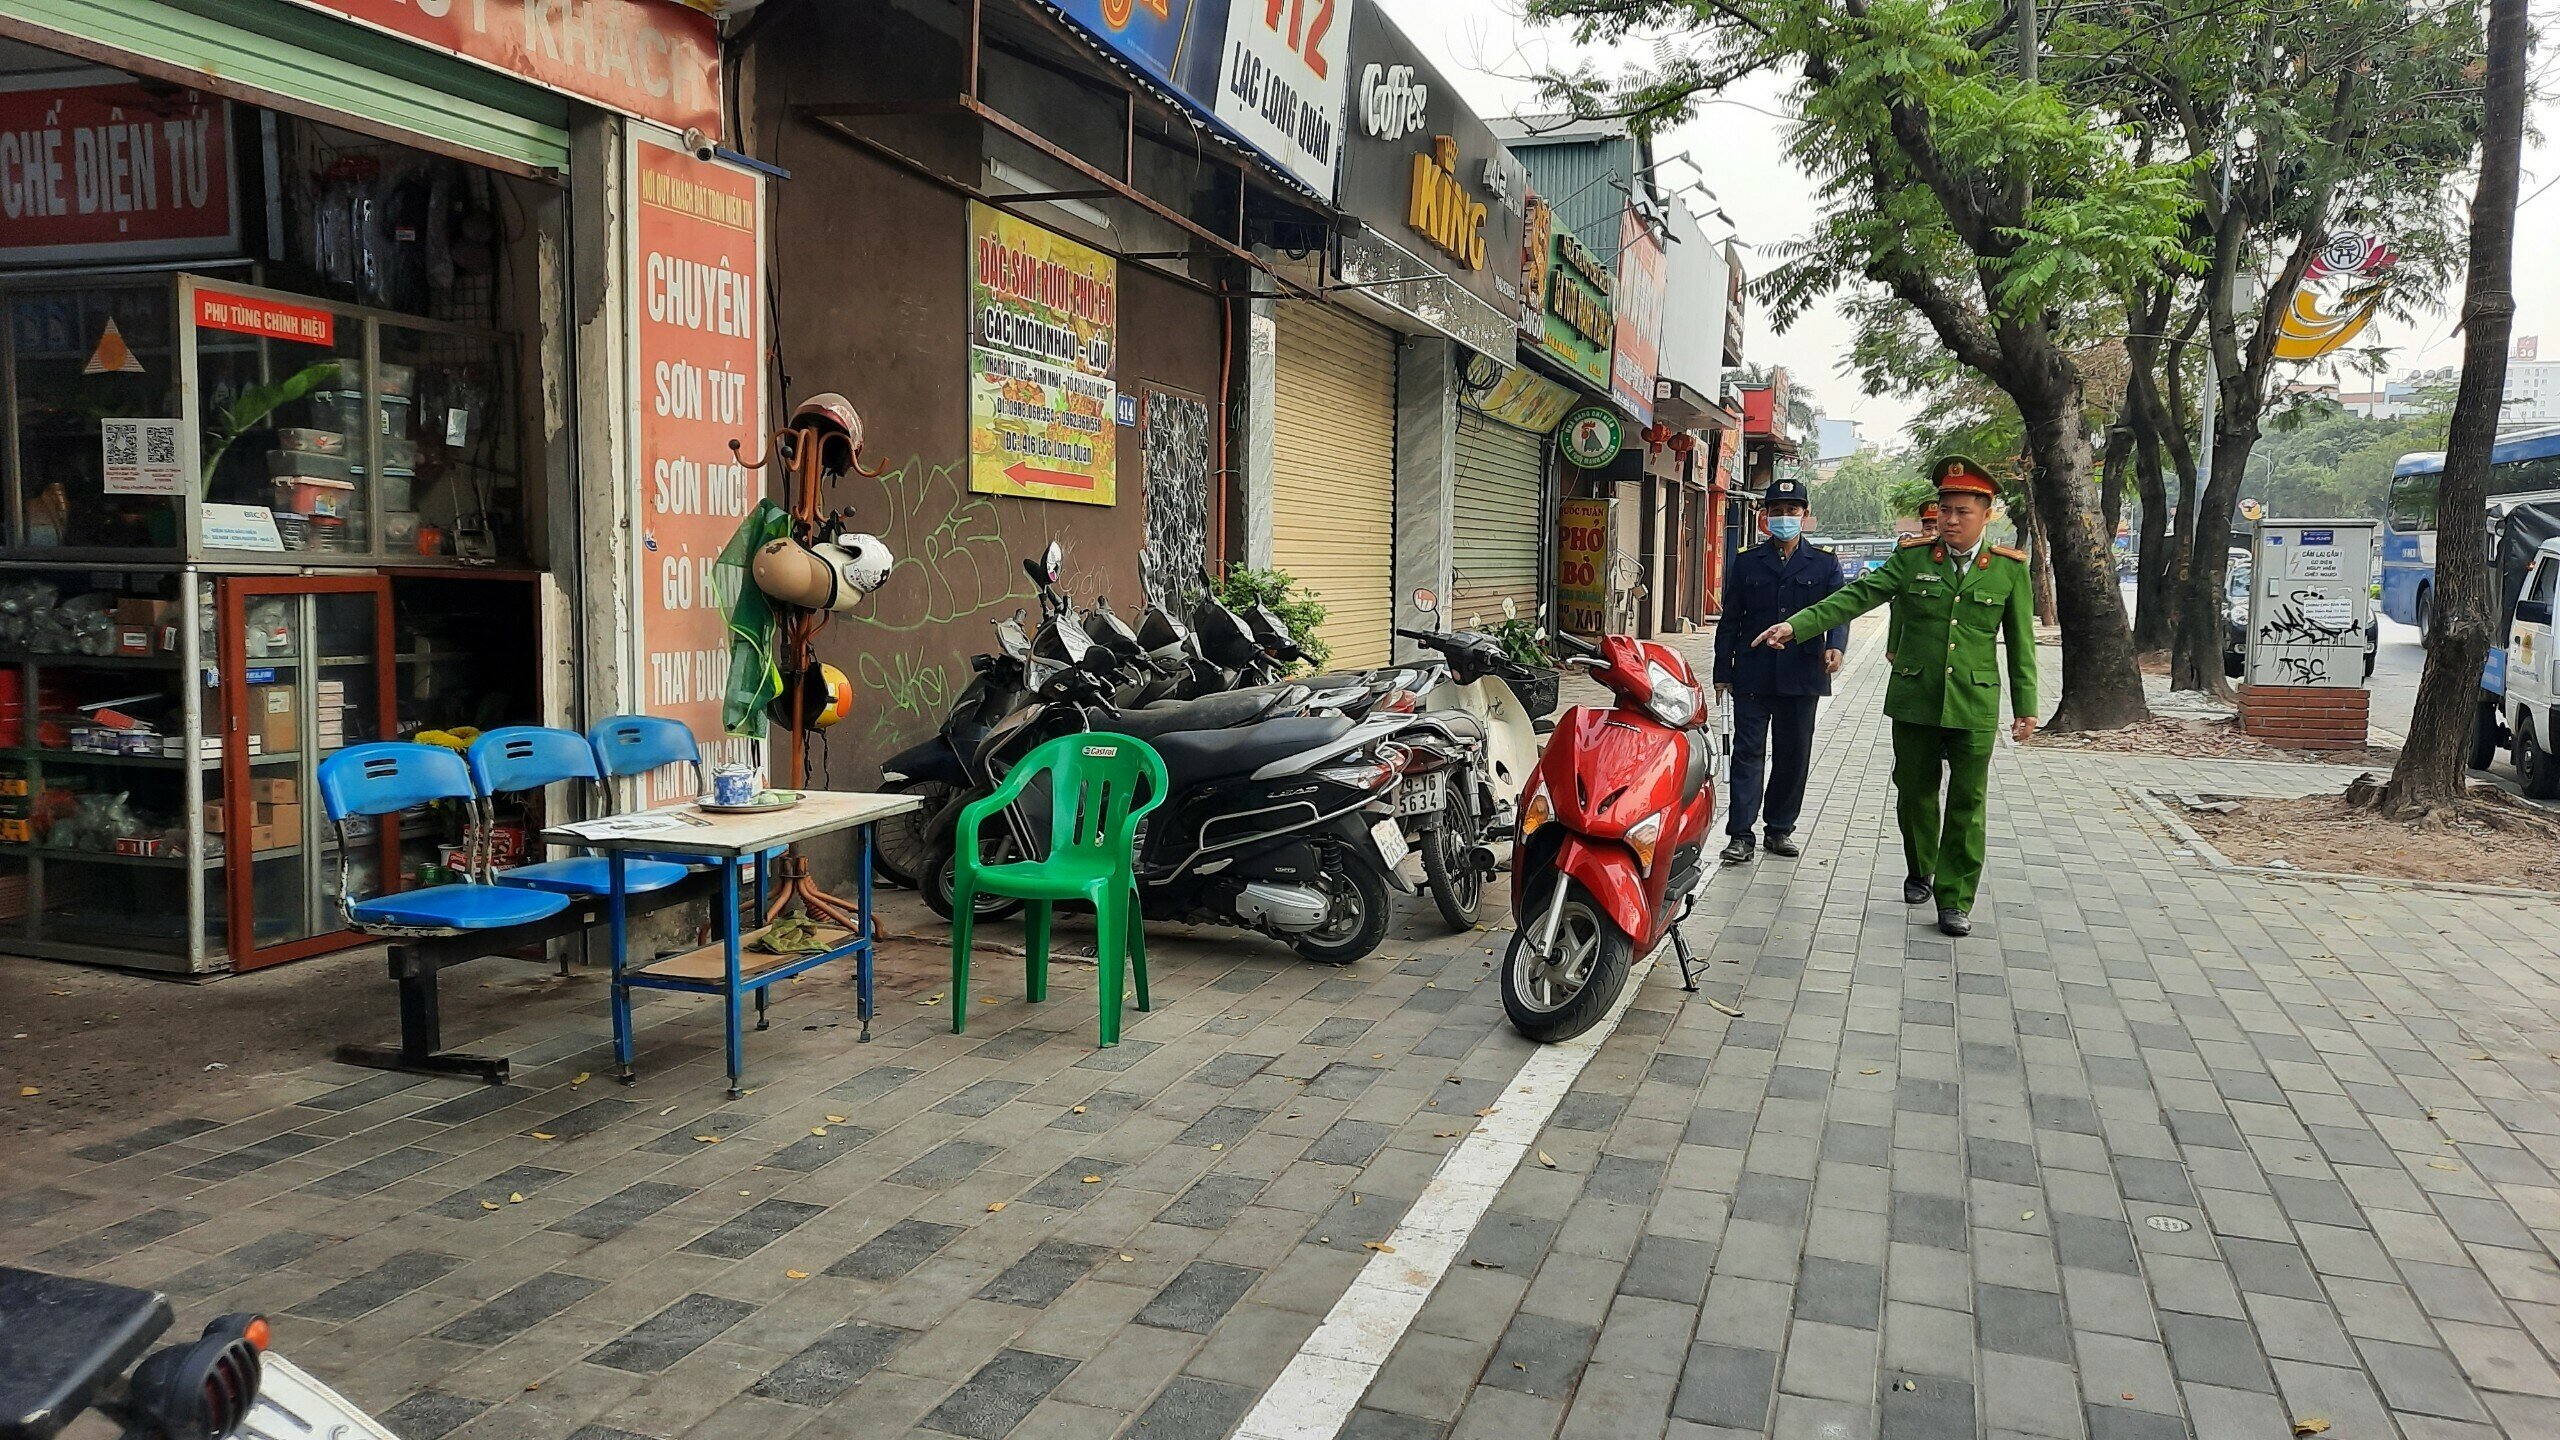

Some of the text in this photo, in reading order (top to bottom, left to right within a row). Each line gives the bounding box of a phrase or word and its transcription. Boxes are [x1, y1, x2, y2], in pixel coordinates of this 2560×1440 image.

[1230, 40, 1261, 111] LẠC
[1261, 67, 1298, 138] LONG
[1298, 102, 1332, 166] QUÂN
[1359, 63, 1428, 142] Coffee
[0, 91, 209, 232] CHẾ ĐIỆN TỬ
[671, 173, 694, 213] KHÁCH
[1409, 151, 1487, 271] KING
[647, 252, 751, 339] CHUYÊN
[978, 231, 1008, 300] ĐẶC
[1010, 240, 1038, 303] SẢN
[1072, 262, 1095, 322] PHỐ
[1098, 269, 1114, 328] CỔ
[204, 302, 326, 342] PHỤ TÙNG CHÍNH HIỆU
[985, 303, 1012, 346] CÁC
[1013, 313, 1043, 355] MÓN
[1045, 324, 1077, 368] NHẬU
[655, 359, 746, 426] SƠN TÚT
[1118, 400, 1134, 422] 414
[1006, 431, 1020, 452] ĐC:
[1023, 434, 1036, 453] 416
[1055, 440, 1072, 460] Long
[654, 456, 702, 515] SƠN
[1560, 518, 1606, 552] PHỞ
[662, 544, 692, 611] GÒ
[1562, 555, 1595, 586] BÒ
[652, 651, 691, 706] THAY
[1091, 747, 1115, 755] Castrol
[1267, 786, 1319, 799] LEAD
[1399, 792, 1437, 813] 5634
